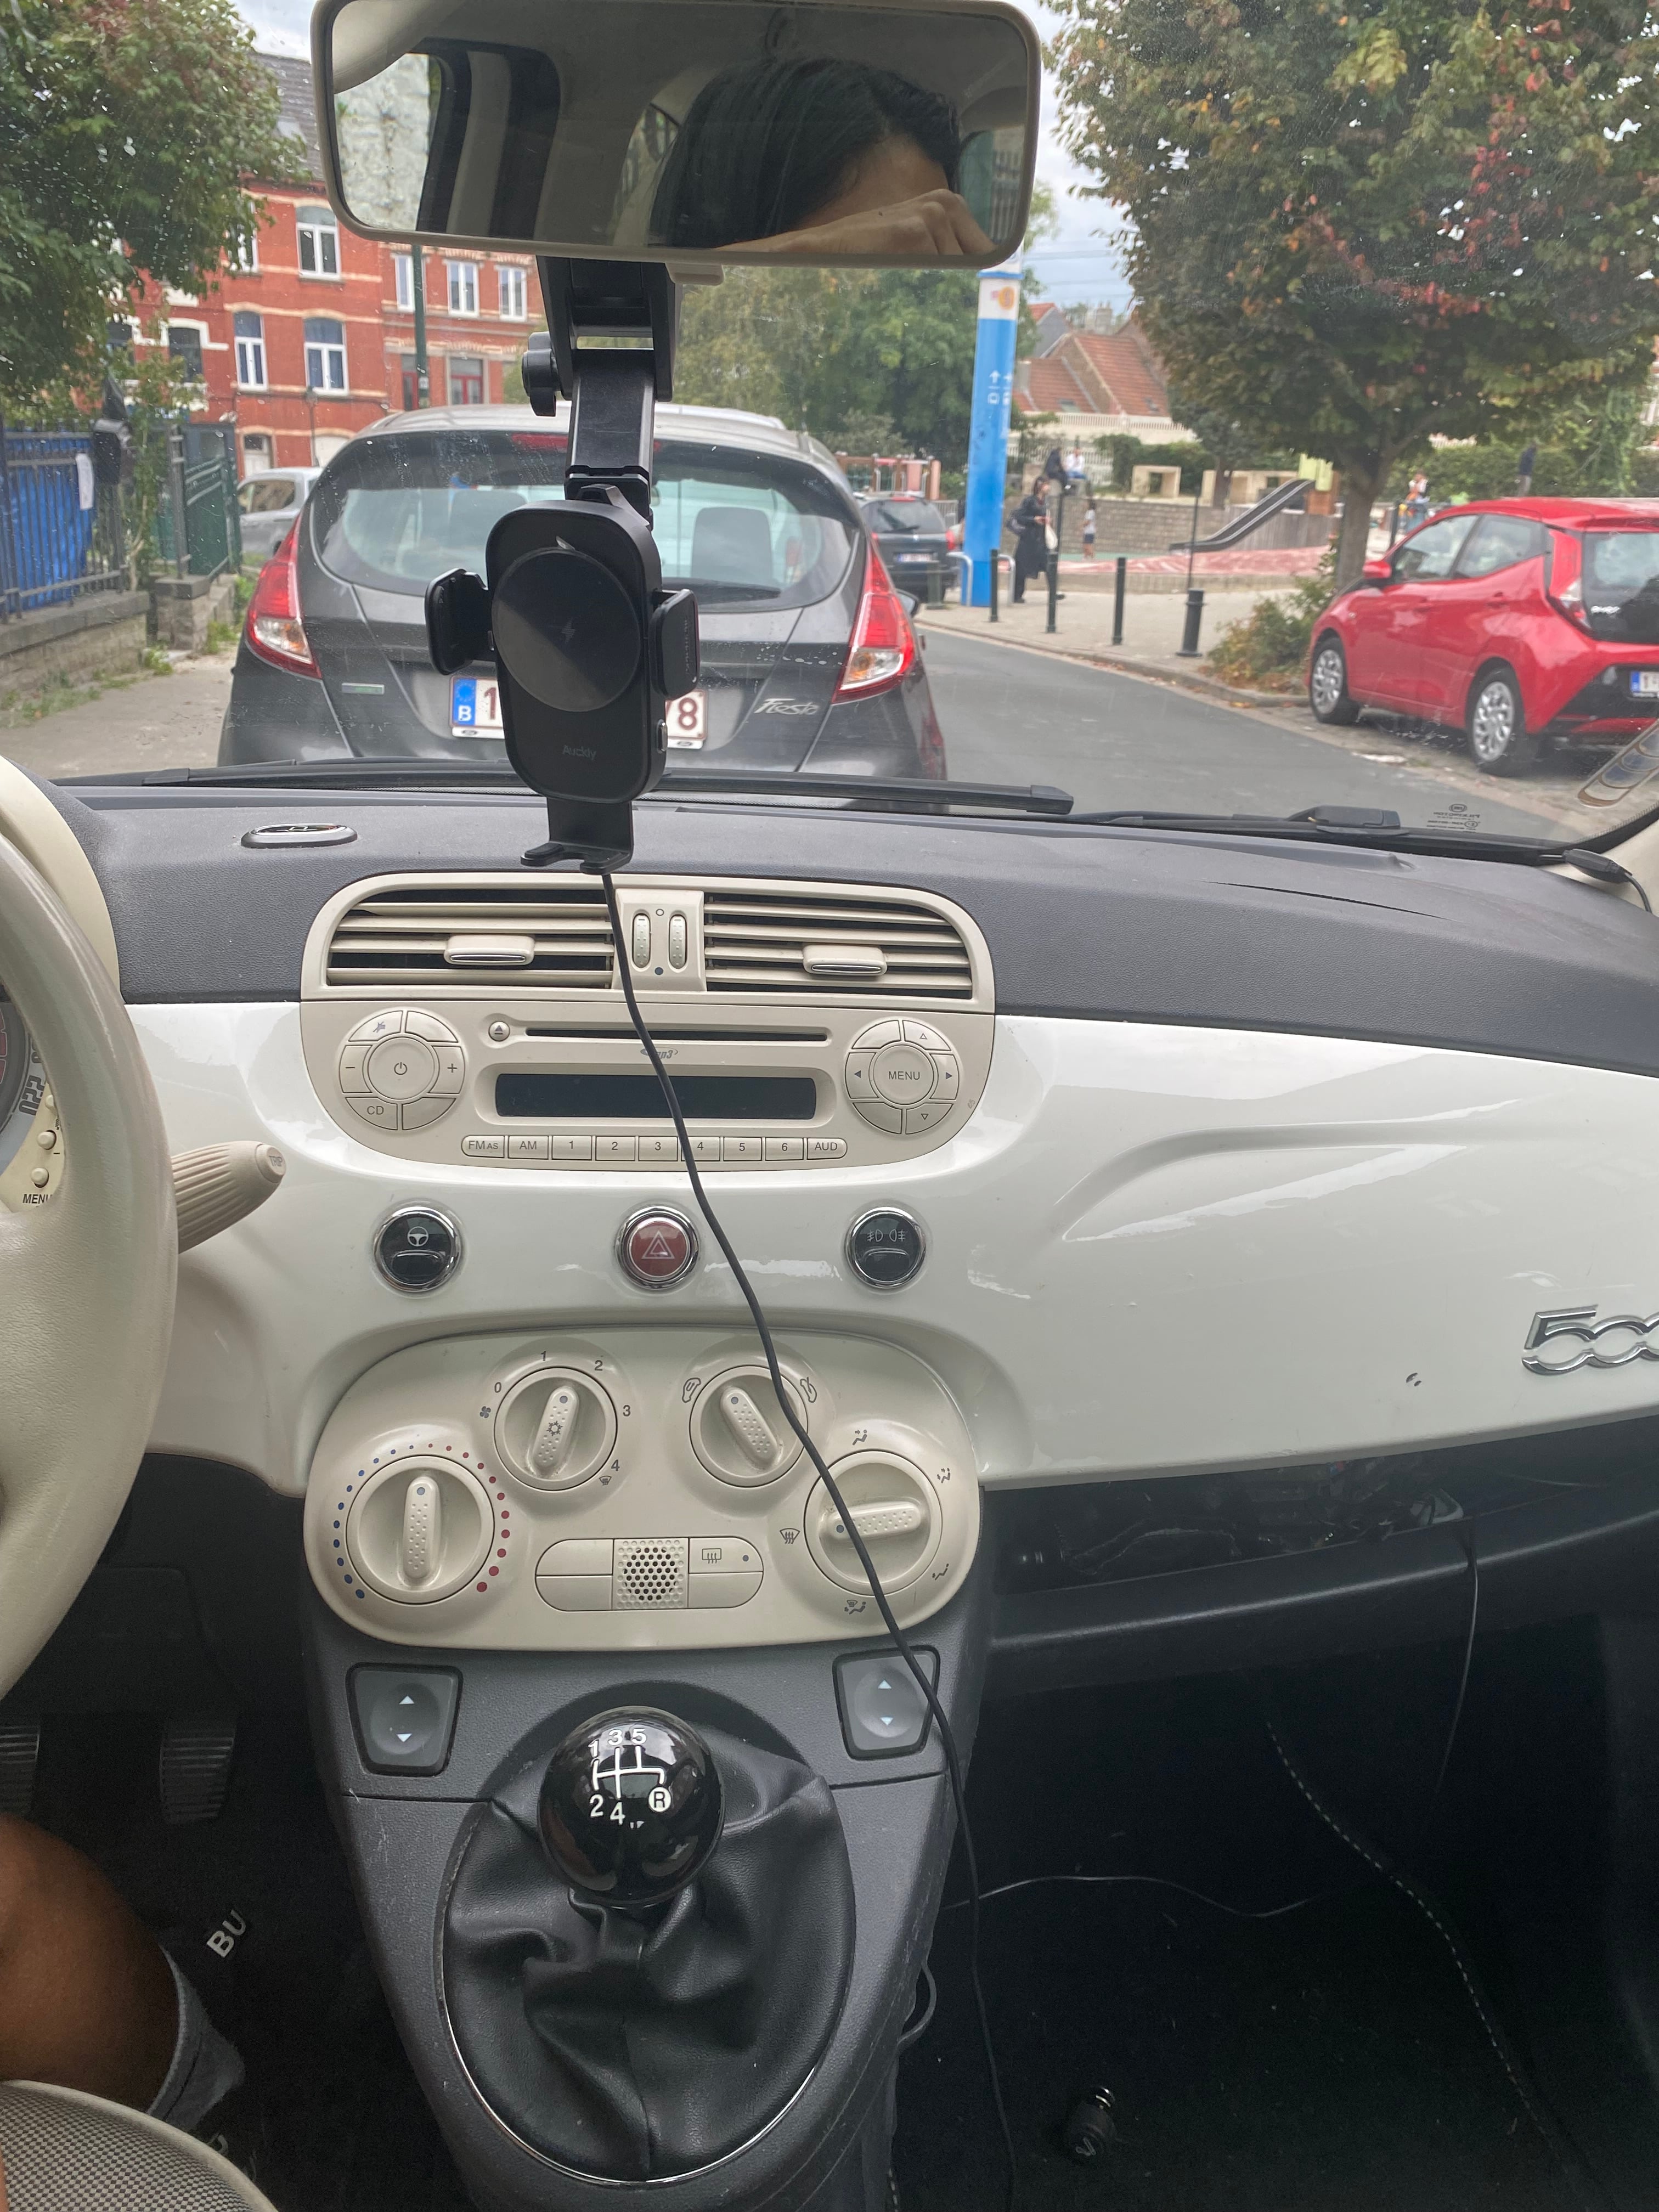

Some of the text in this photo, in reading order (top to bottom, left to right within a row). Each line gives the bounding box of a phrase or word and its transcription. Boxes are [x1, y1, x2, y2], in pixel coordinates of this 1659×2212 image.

[754, 698, 819, 715] Fiesta
[458, 706, 471, 721] B
[562, 745, 596, 760] Auckly
[889, 1071, 920, 1080] MENU
[367, 1105, 384, 1115] CD
[469, 1141, 485, 1150] FM
[520, 1141, 537, 1150] AM
[569, 1141, 574, 1149] 1
[611, 1142, 618, 1150] 2
[654, 1142, 662, 1151] 3
[697, 1142, 704, 1151] 4
[739, 1142, 746, 1152] 5
[781, 1142, 788, 1152] 6
[814, 1142, 838, 1151] AUD
[540, 1351, 548, 1362] 1
[594, 1359, 603, 1372] 2
[493, 1381, 502, 1393] 0
[622, 1404, 631, 1417] 3
[611, 1459, 620, 1472] 4
[608, 1728, 647, 1746] 3 5
[588, 1739, 599, 1758] 1
[653, 1791, 665, 1809] R
[589, 1794, 625, 1826] 2 4
[206, 1909, 246, 1958] BU
